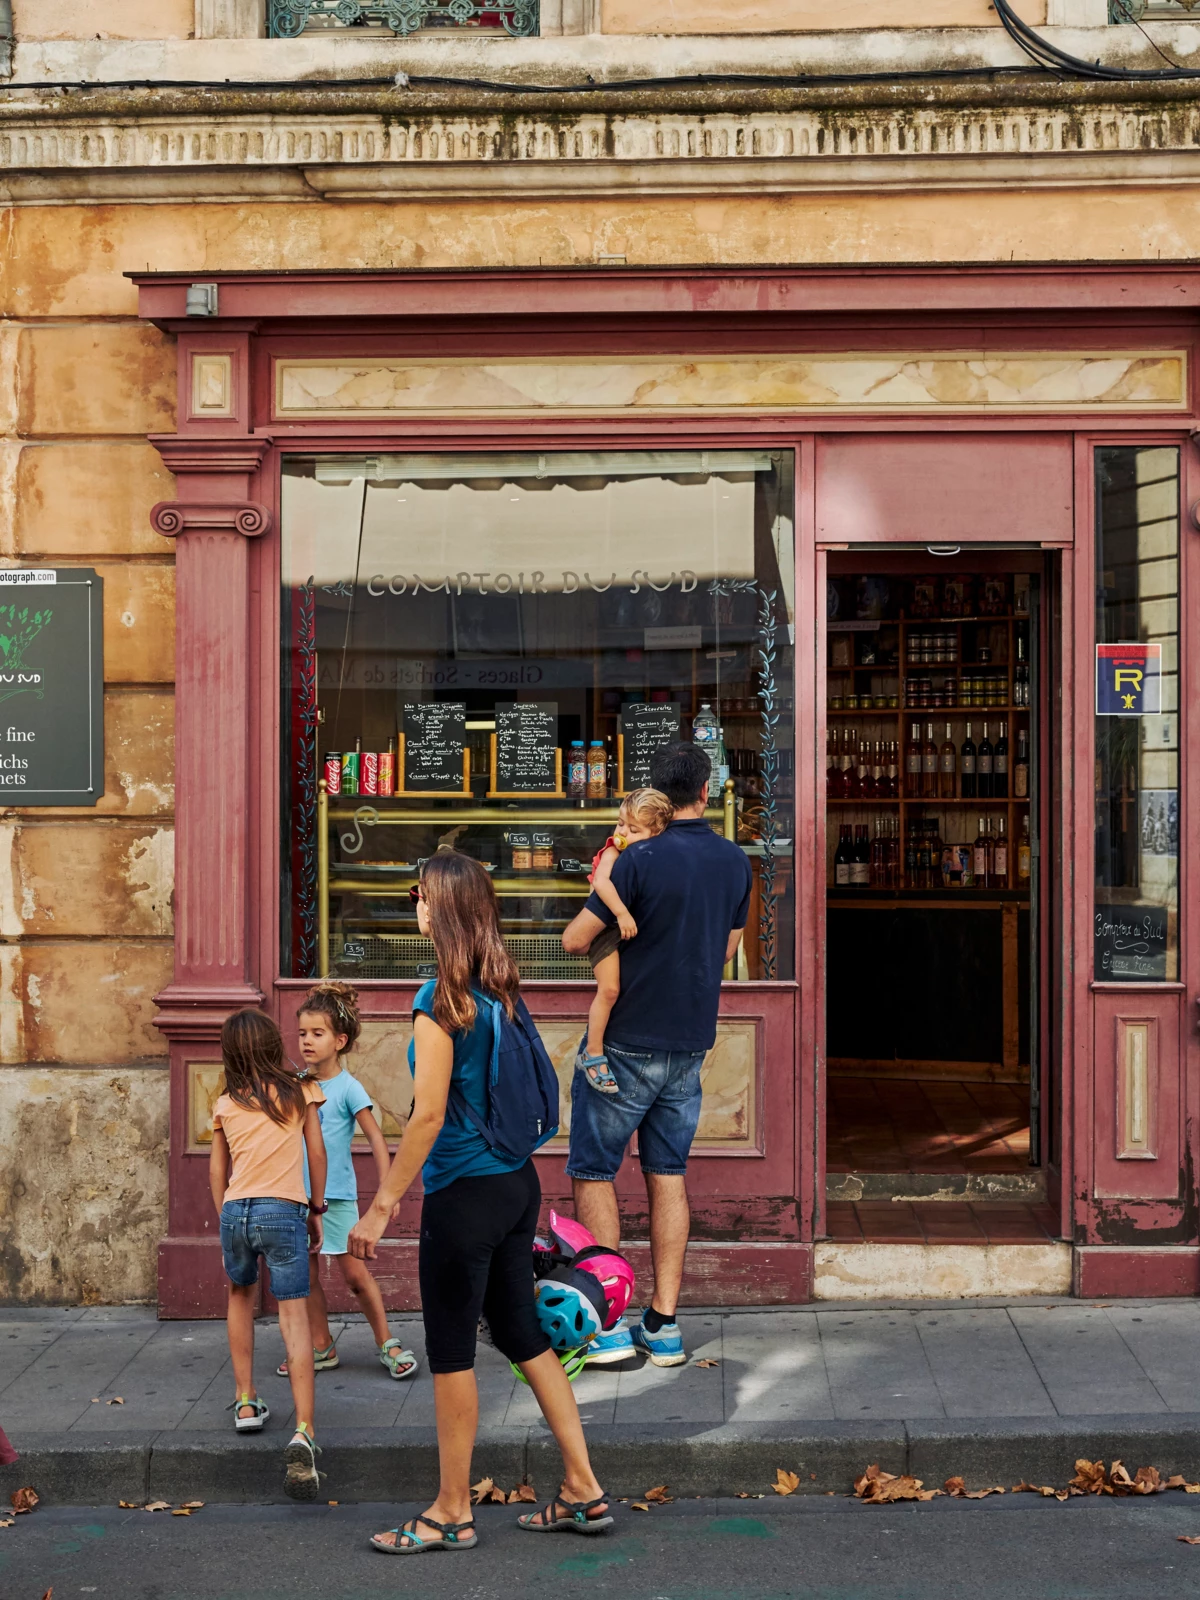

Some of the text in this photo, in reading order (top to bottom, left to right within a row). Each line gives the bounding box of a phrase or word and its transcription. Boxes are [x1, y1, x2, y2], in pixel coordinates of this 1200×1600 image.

[366, 570, 698, 597] COMPTOIR DU SUD
[18, 673, 41, 683] SUD
[1115, 669, 1143, 691] R
[6, 726, 36, 742] fine
[1142, 916, 1164, 939] Sud
